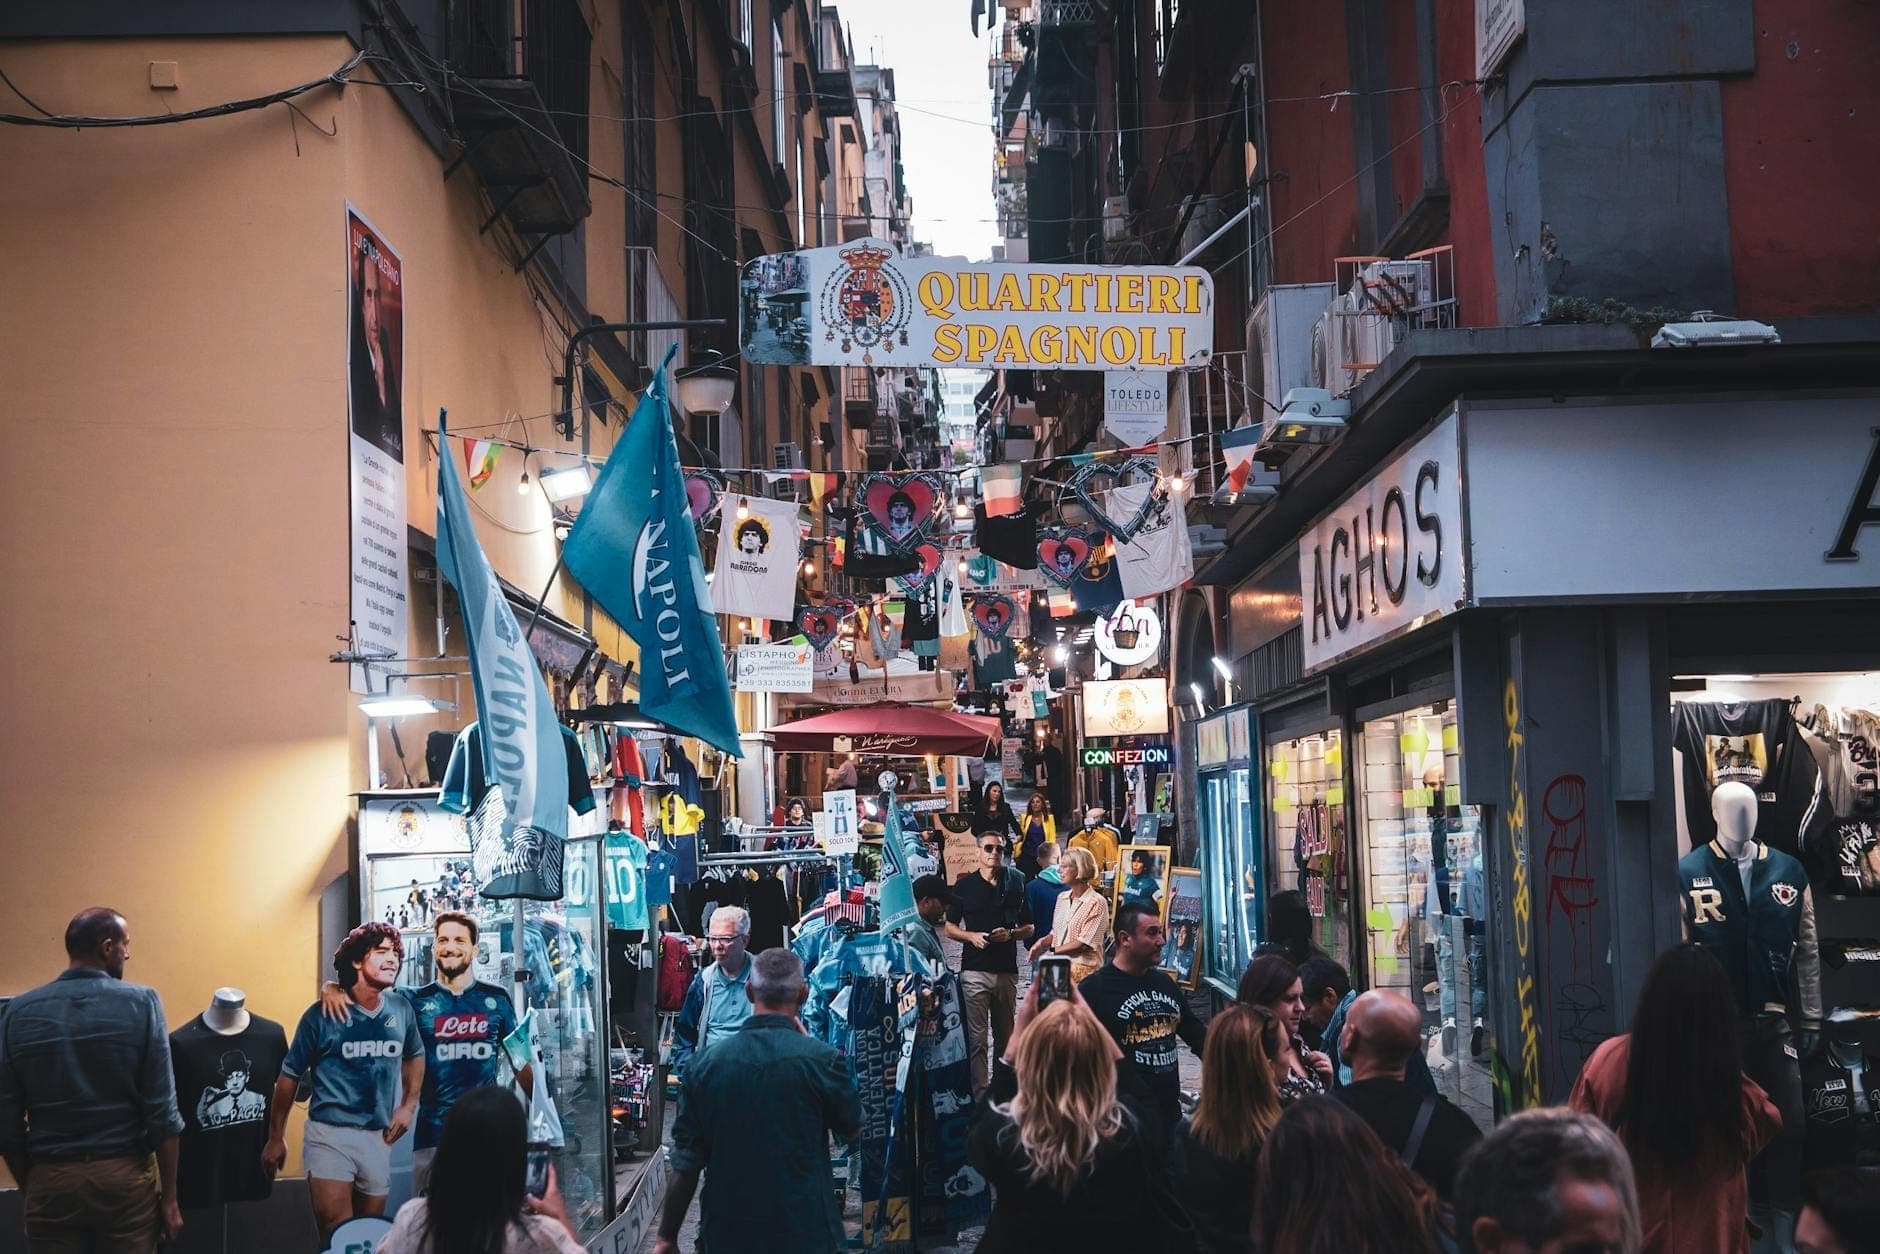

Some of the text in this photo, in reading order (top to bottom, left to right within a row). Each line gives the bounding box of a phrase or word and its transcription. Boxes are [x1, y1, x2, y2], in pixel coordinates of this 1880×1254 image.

[917, 270, 1207, 320] QUARTIERI
[931, 324, 1186, 366] SPAGNOLI
[1108, 400, 1165, 412] LIFESTYLE
[1111, 389, 1160, 400] TOLEDO
[1311, 459, 1443, 644] AGHOS
[642, 517, 691, 690] NAPOLI
[739, 651, 811, 660] LISTAPHOO
[1084, 748, 1168, 765] CONFEZION
[829, 837, 844, 846] SOLO
[1300, 804, 1332, 861] SALDI
[605, 858, 637, 904] 10
[1689, 888, 1727, 924] R
[1117, 990, 1151, 1020] OFFICIAL
[435, 1015, 490, 1038] Lete
[342, 1039, 404, 1060] CIRIO
[436, 1041, 494, 1062] CIRO
[855, 1027, 868, 1063] NON
[856, 1069, 870, 1106] AMA
[867, 1025, 886, 1140] DIMENTICA
